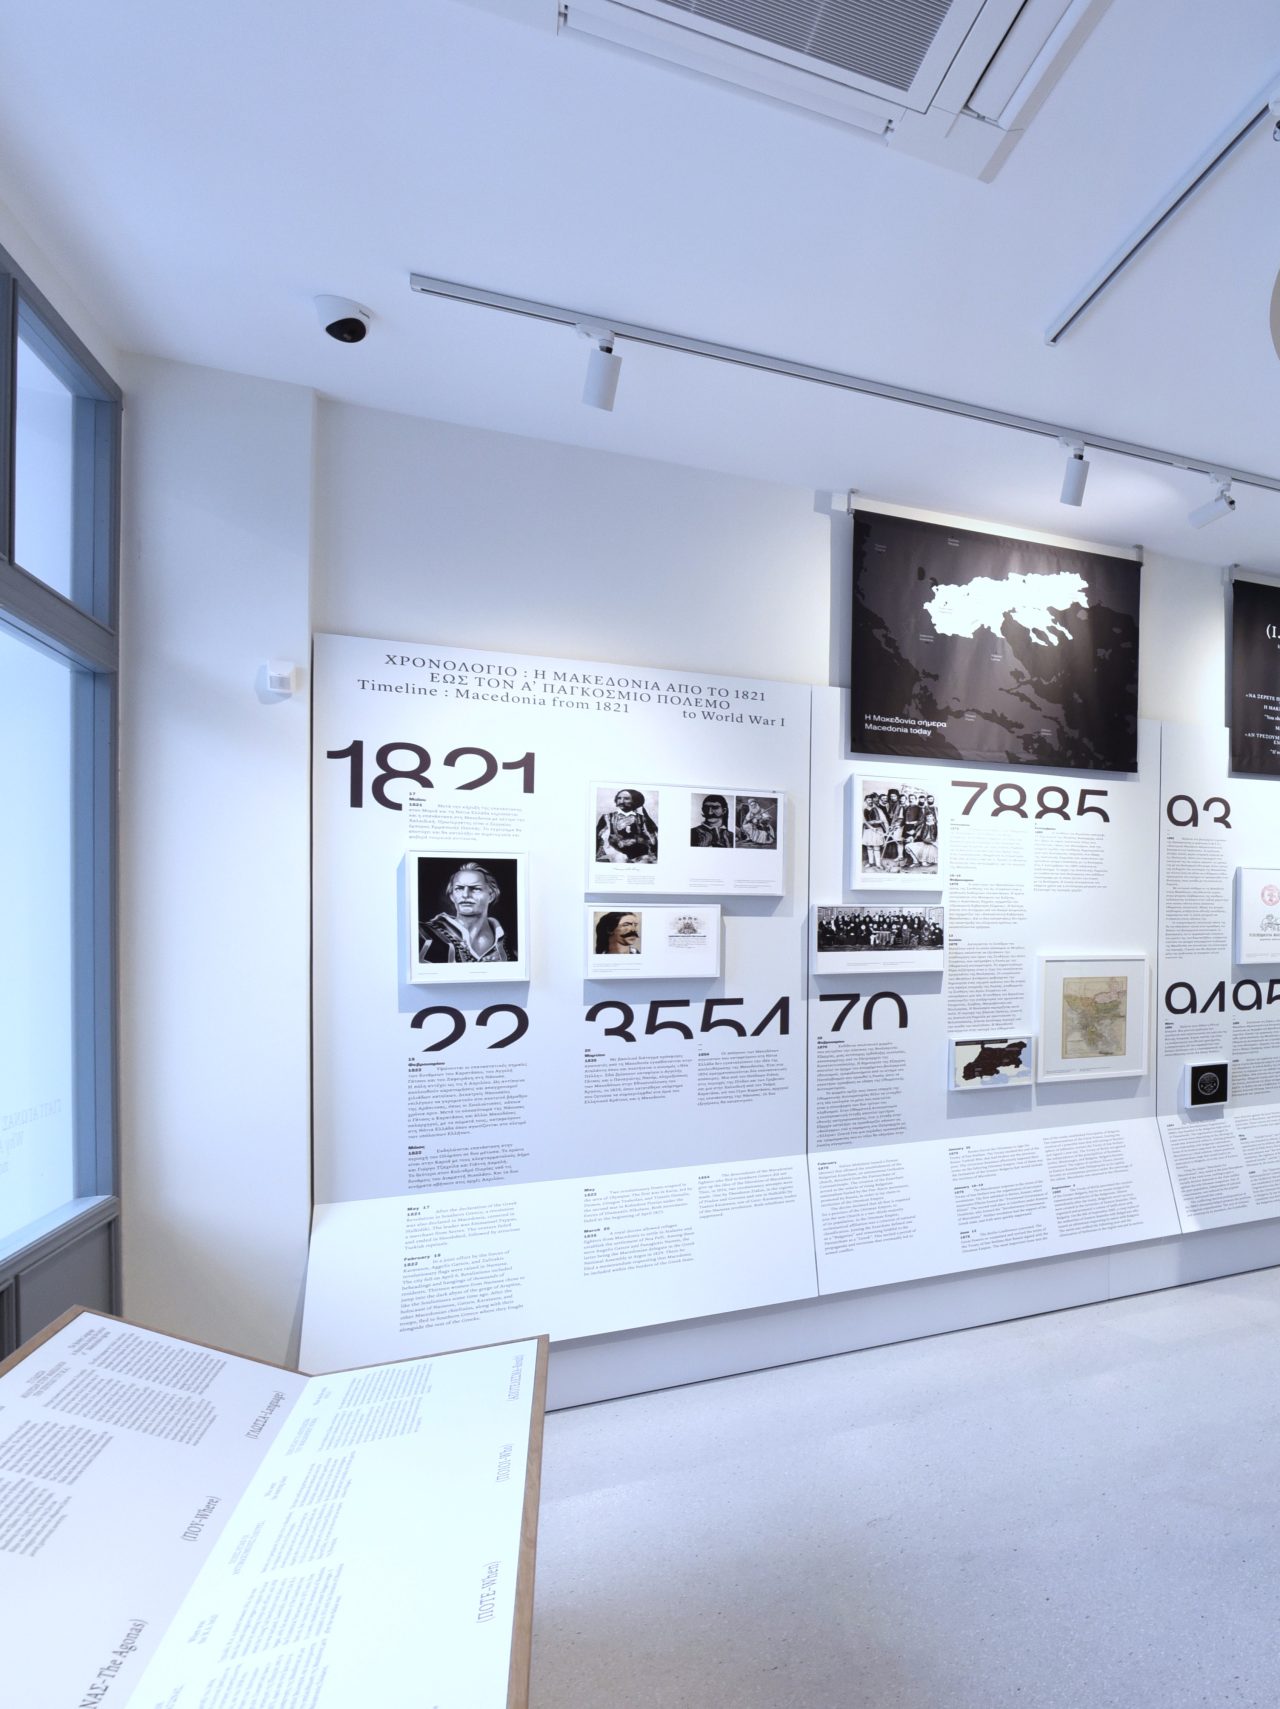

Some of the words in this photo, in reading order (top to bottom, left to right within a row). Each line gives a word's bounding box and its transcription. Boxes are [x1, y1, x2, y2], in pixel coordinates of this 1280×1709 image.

[384, 653, 518, 677] ΧΡΟΝΟΛΟΓΙΟ
[553, 671, 661, 691] ΜΑΚΕΔΟΝΙΑ
[666, 682, 702, 695] ΑΠΟ
[707, 686, 729, 698] ΤΟ
[734, 689, 766, 702] 1821
[430, 672, 468, 686] ΕΩΣ
[475, 676, 514, 690] ΤΟΝ
[543, 683, 652, 703] ΠΑΓΚΟΣΜΙΟ
[657, 694, 731, 711] ΠΟΛΕΜΟ
[357, 678, 438, 697] Timeline
[455, 688, 546, 707] Macedonia
[552, 696, 590, 711] from
[595, 700, 630, 714] 1821
[682, 709, 697, 720] to
[701, 710, 744, 724] World
[749, 714, 776, 727] War
[864, 723, 908, 734] Macedonia
[910, 727, 932, 737] today
[872, 714, 916, 726] Μακεδονία
[917, 719, 947, 728] σήμερα
[112, 1618, 149, 1658] Agonas)
